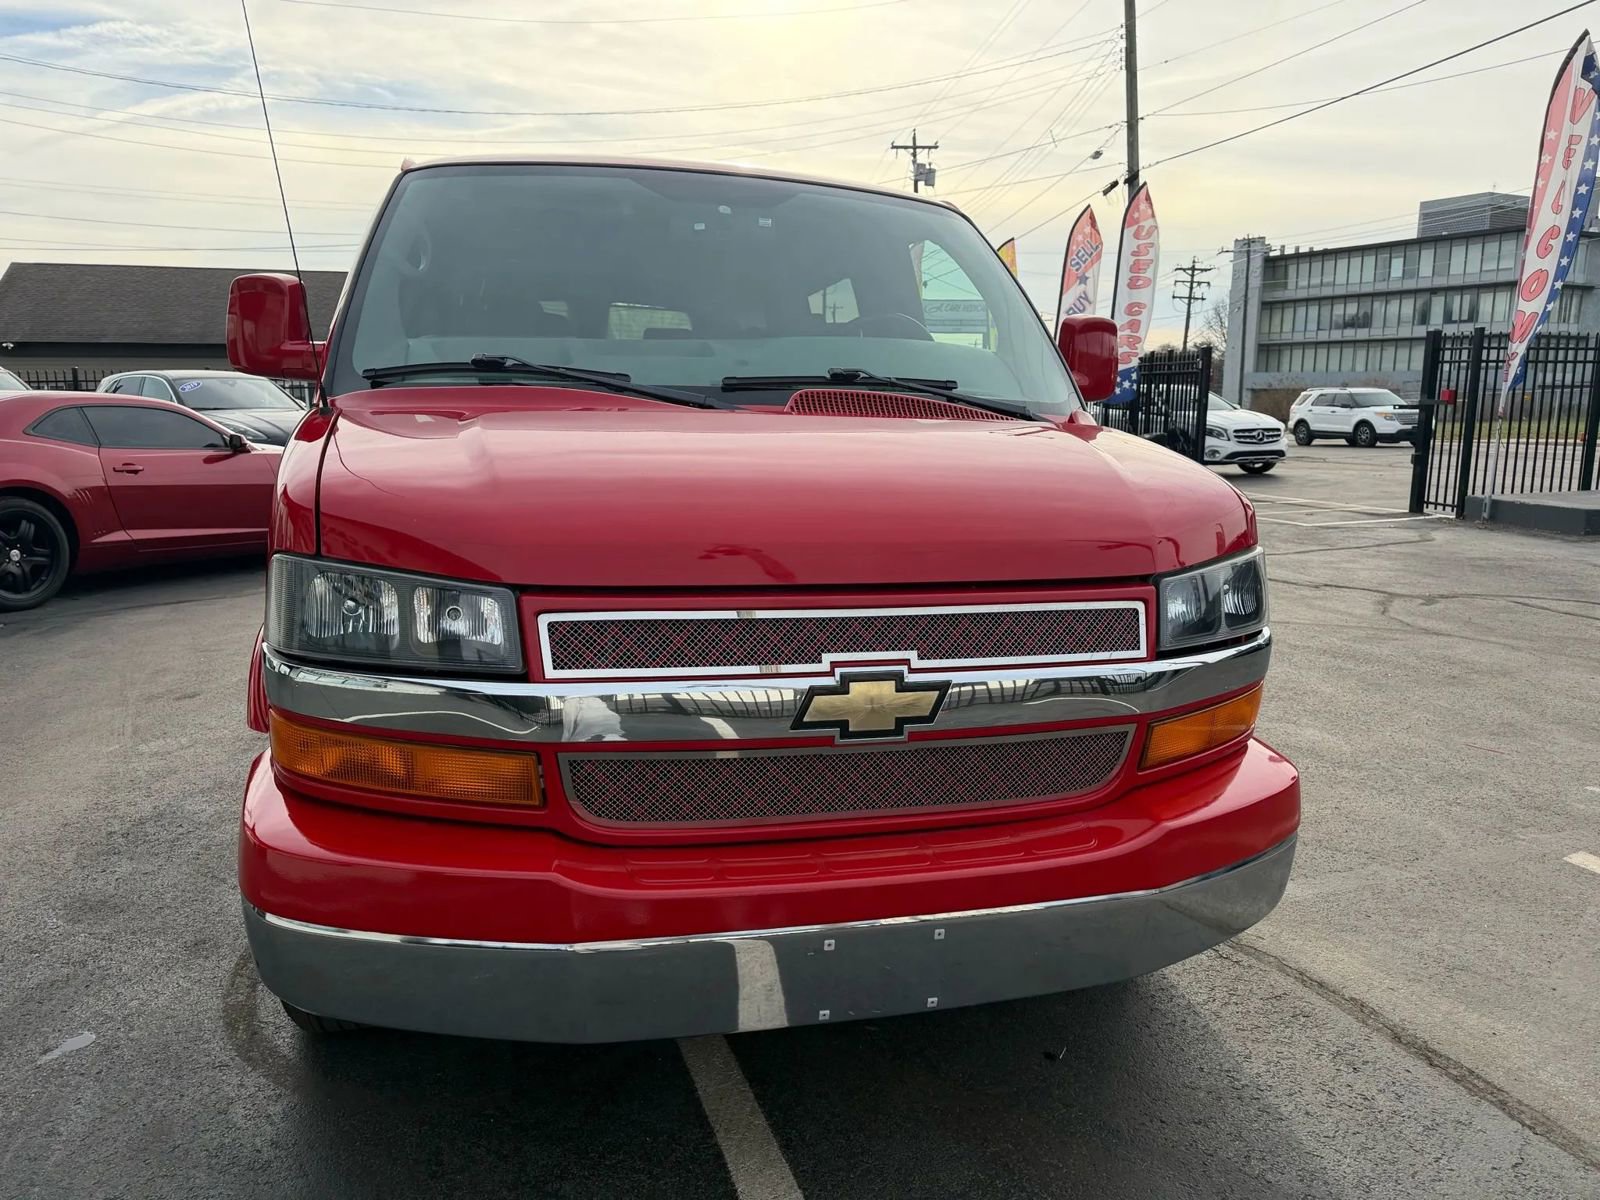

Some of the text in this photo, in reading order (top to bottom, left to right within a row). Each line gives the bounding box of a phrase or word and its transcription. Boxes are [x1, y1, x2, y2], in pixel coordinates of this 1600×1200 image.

[1070, 240, 1101, 272] SELL
[1118, 224, 1157, 364] USED CARS
